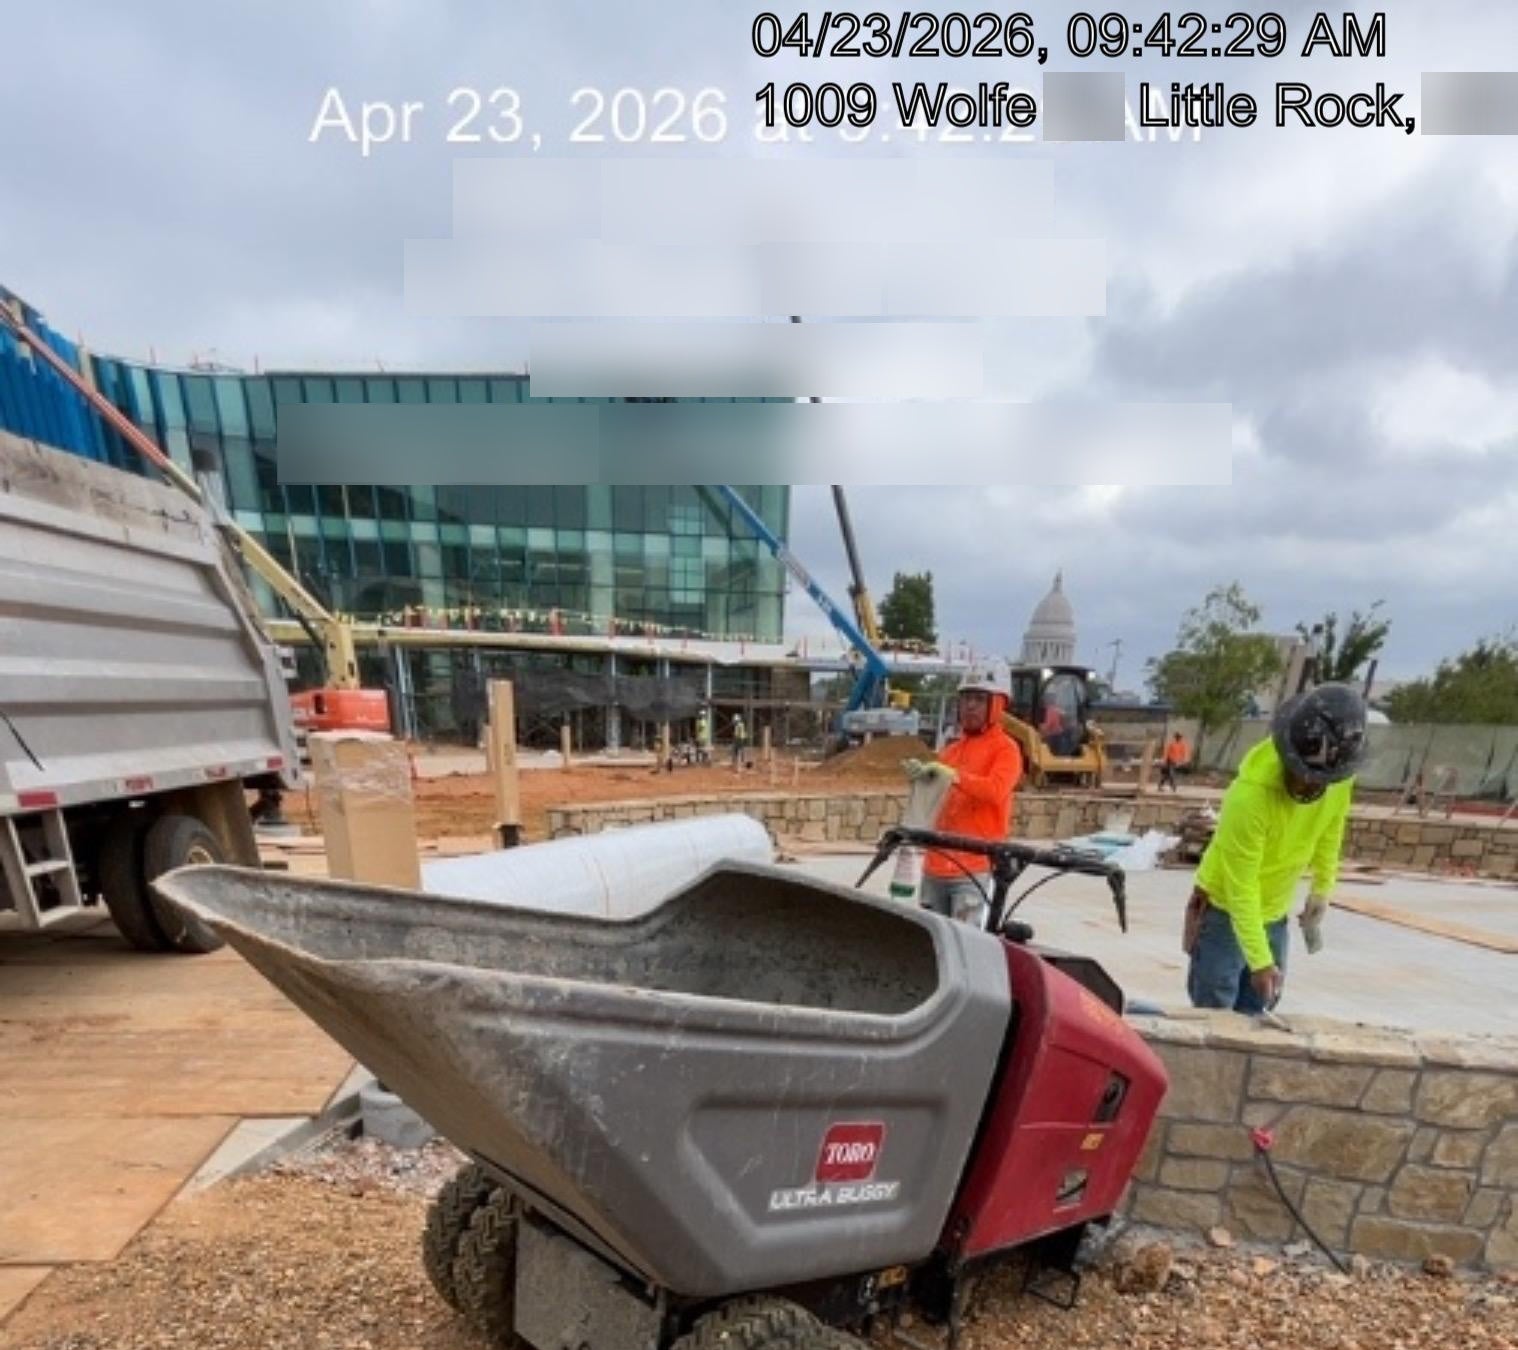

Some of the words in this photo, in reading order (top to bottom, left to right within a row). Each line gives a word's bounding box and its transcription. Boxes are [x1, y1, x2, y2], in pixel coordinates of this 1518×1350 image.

[824, 1142, 876, 1164] TORO
[768, 1188, 832, 1212] ULTRA
[836, 1181, 900, 1205] BUGGY
